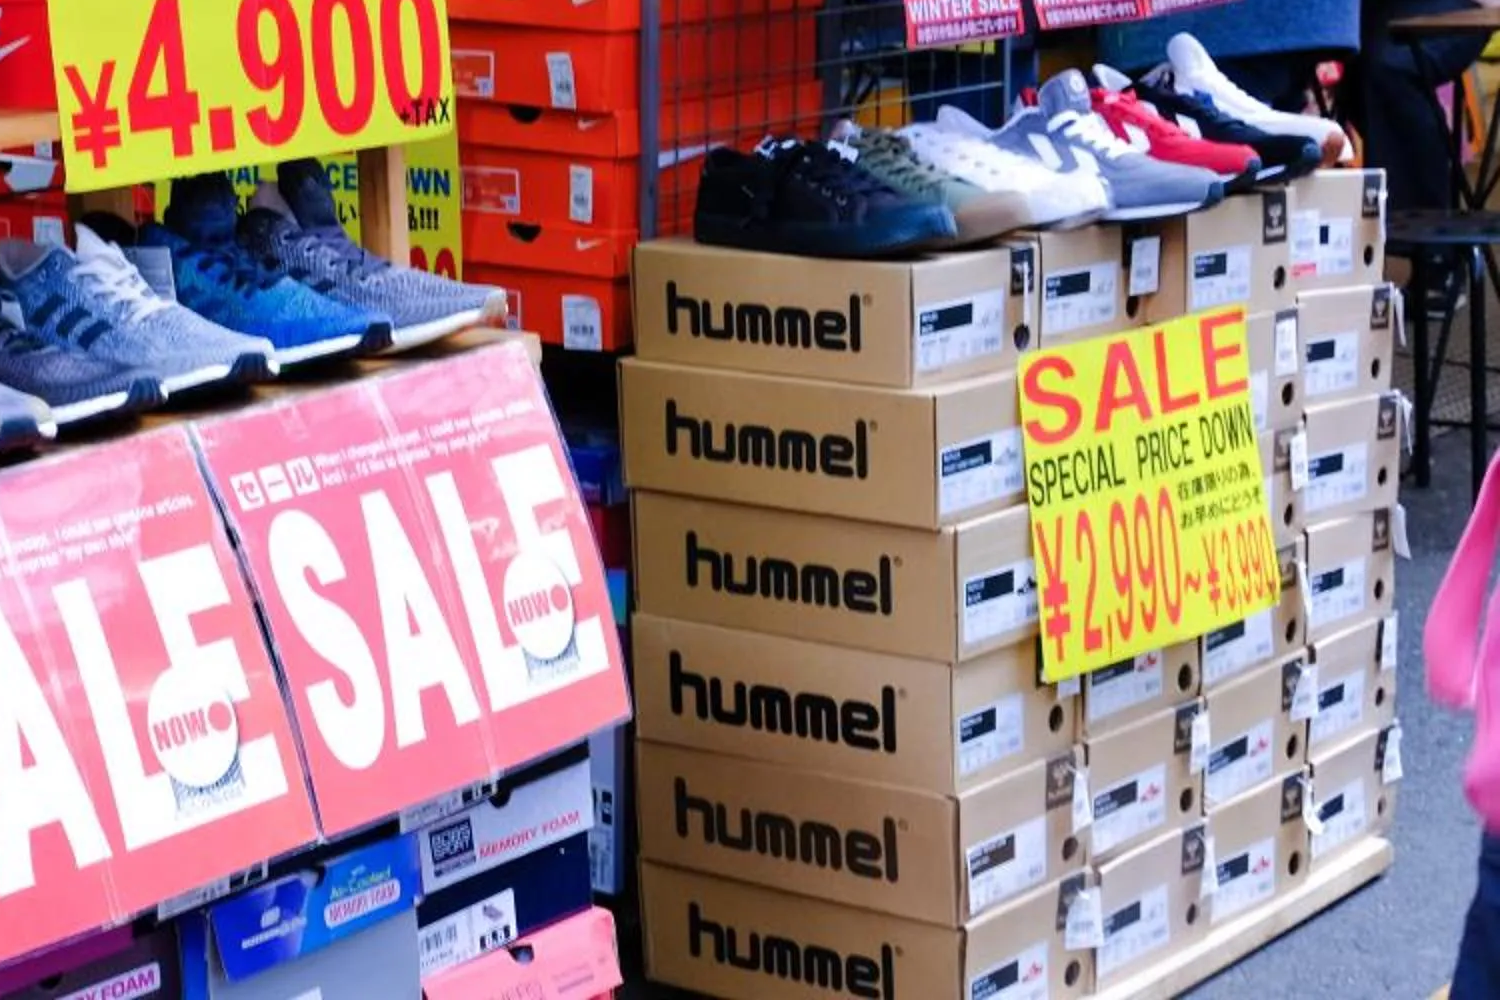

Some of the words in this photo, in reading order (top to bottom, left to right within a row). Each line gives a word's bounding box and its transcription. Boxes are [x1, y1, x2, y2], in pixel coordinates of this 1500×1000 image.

[400, 97, 451, 128] +TAX
[665, 280, 862, 353] hummel
[1022, 311, 1249, 445] SALE
[665, 399, 868, 481] hummel
[1029, 445, 1127, 508] SPECIAL
[1136, 424, 1191, 481] PRICE
[1199, 402, 1255, 459] DOWN
[236, 459, 314, 504] セール
[267, 444, 610, 770] SALE
[508, 588, 552, 628] NOW
[686, 530, 893, 617] hummel
[153, 706, 208, 752] NOW
[669, 650, 898, 754] hummel
[480, 829, 536, 858] MEMORY
[543, 812, 581, 837] FOAM
[673, 776, 900, 883] hummel
[99, 969, 157, 998] FOAM
[688, 901, 895, 1000] hummel
